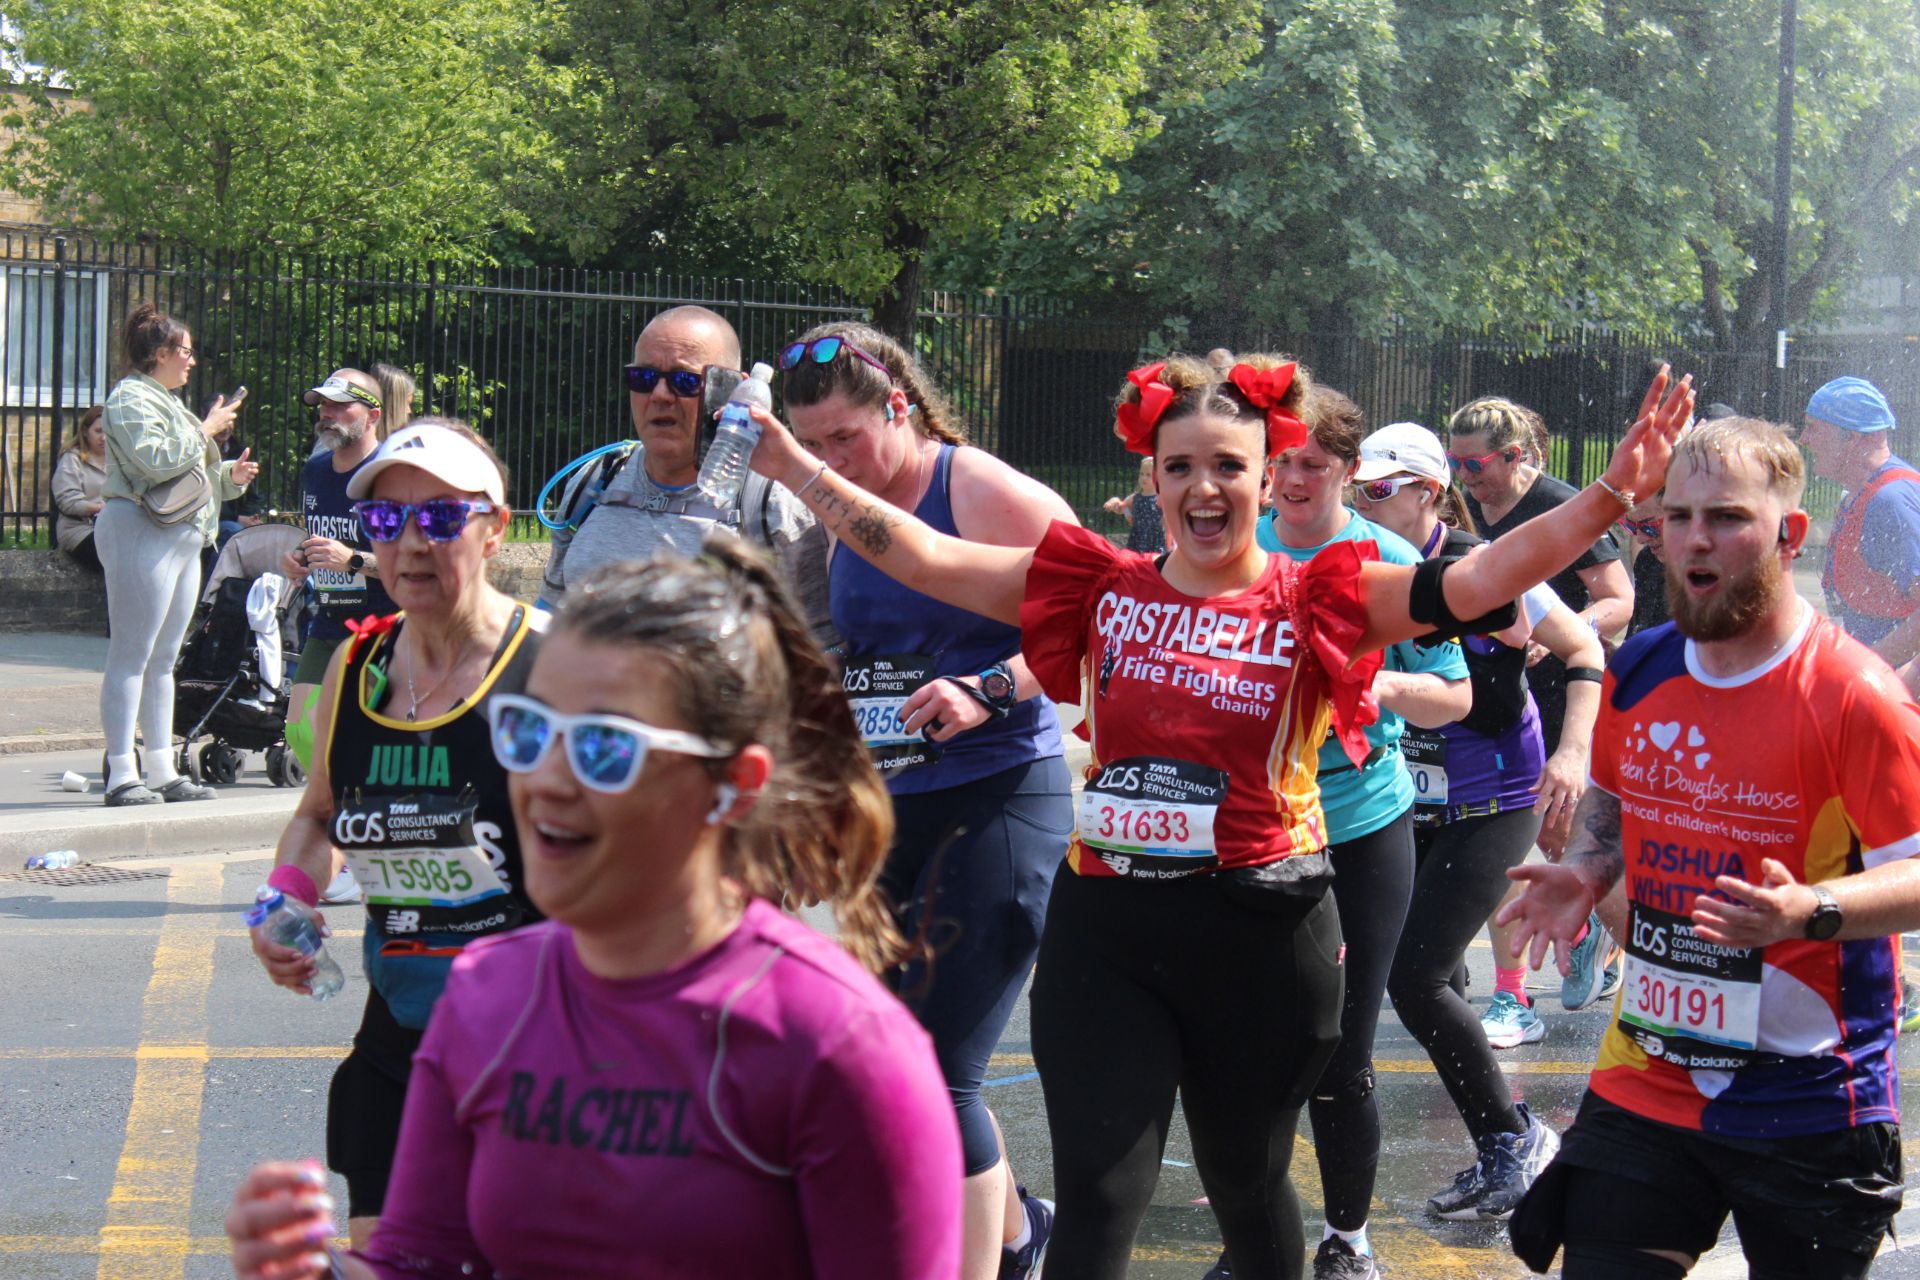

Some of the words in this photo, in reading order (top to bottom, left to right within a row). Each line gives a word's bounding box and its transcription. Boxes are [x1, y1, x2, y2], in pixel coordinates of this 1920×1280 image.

[307, 515, 359, 543] TORSTEN
[1096, 591, 1295, 668] CRISTABELLE
[873, 661, 894, 671] TATA
[1148, 647, 1175, 663] The
[872, 670, 925, 681] CONSULTANCY
[872, 681, 905, 691] SERVICES
[1122, 656, 1166, 684] Fire
[1171, 665, 1276, 702] Fighters
[1211, 695, 1271, 721] Charity
[365, 745, 450, 787] JULIA
[883, 754, 925, 769] balance
[1149, 763, 1178, 776] TATA
[1141, 783, 1188, 801] SERVICES
[1144, 772, 1217, 798] CONSULTANCY
[1664, 765, 1730, 812] Douglas
[1733, 781, 1800, 810] House
[389, 803, 420, 815] TATA
[335, 809, 385, 844] tcs
[387, 813, 462, 830] CONSULTANCY
[1098, 805, 1190, 844] 31633
[1632, 801, 1660, 822] local
[1664, 814, 1729, 837] children's
[1732, 825, 1795, 846] hospice
[389, 829, 437, 842] SERVICES
[1636, 837, 1748, 881] JOSHUA
[367, 858, 474, 894] 75985
[1132, 868, 1157, 879] new
[447, 911, 507, 934] balance
[1632, 910, 1668, 957] tcs
[1670, 937, 1752, 960] CONSULTANCY
[1670, 949, 1719, 969] SERVICES
[1637, 974, 1725, 1031] 30191
[1664, 1051, 1688, 1066] new
[1689, 1055, 1748, 1069] balance
[503, 1070, 697, 1159] RACHEL
